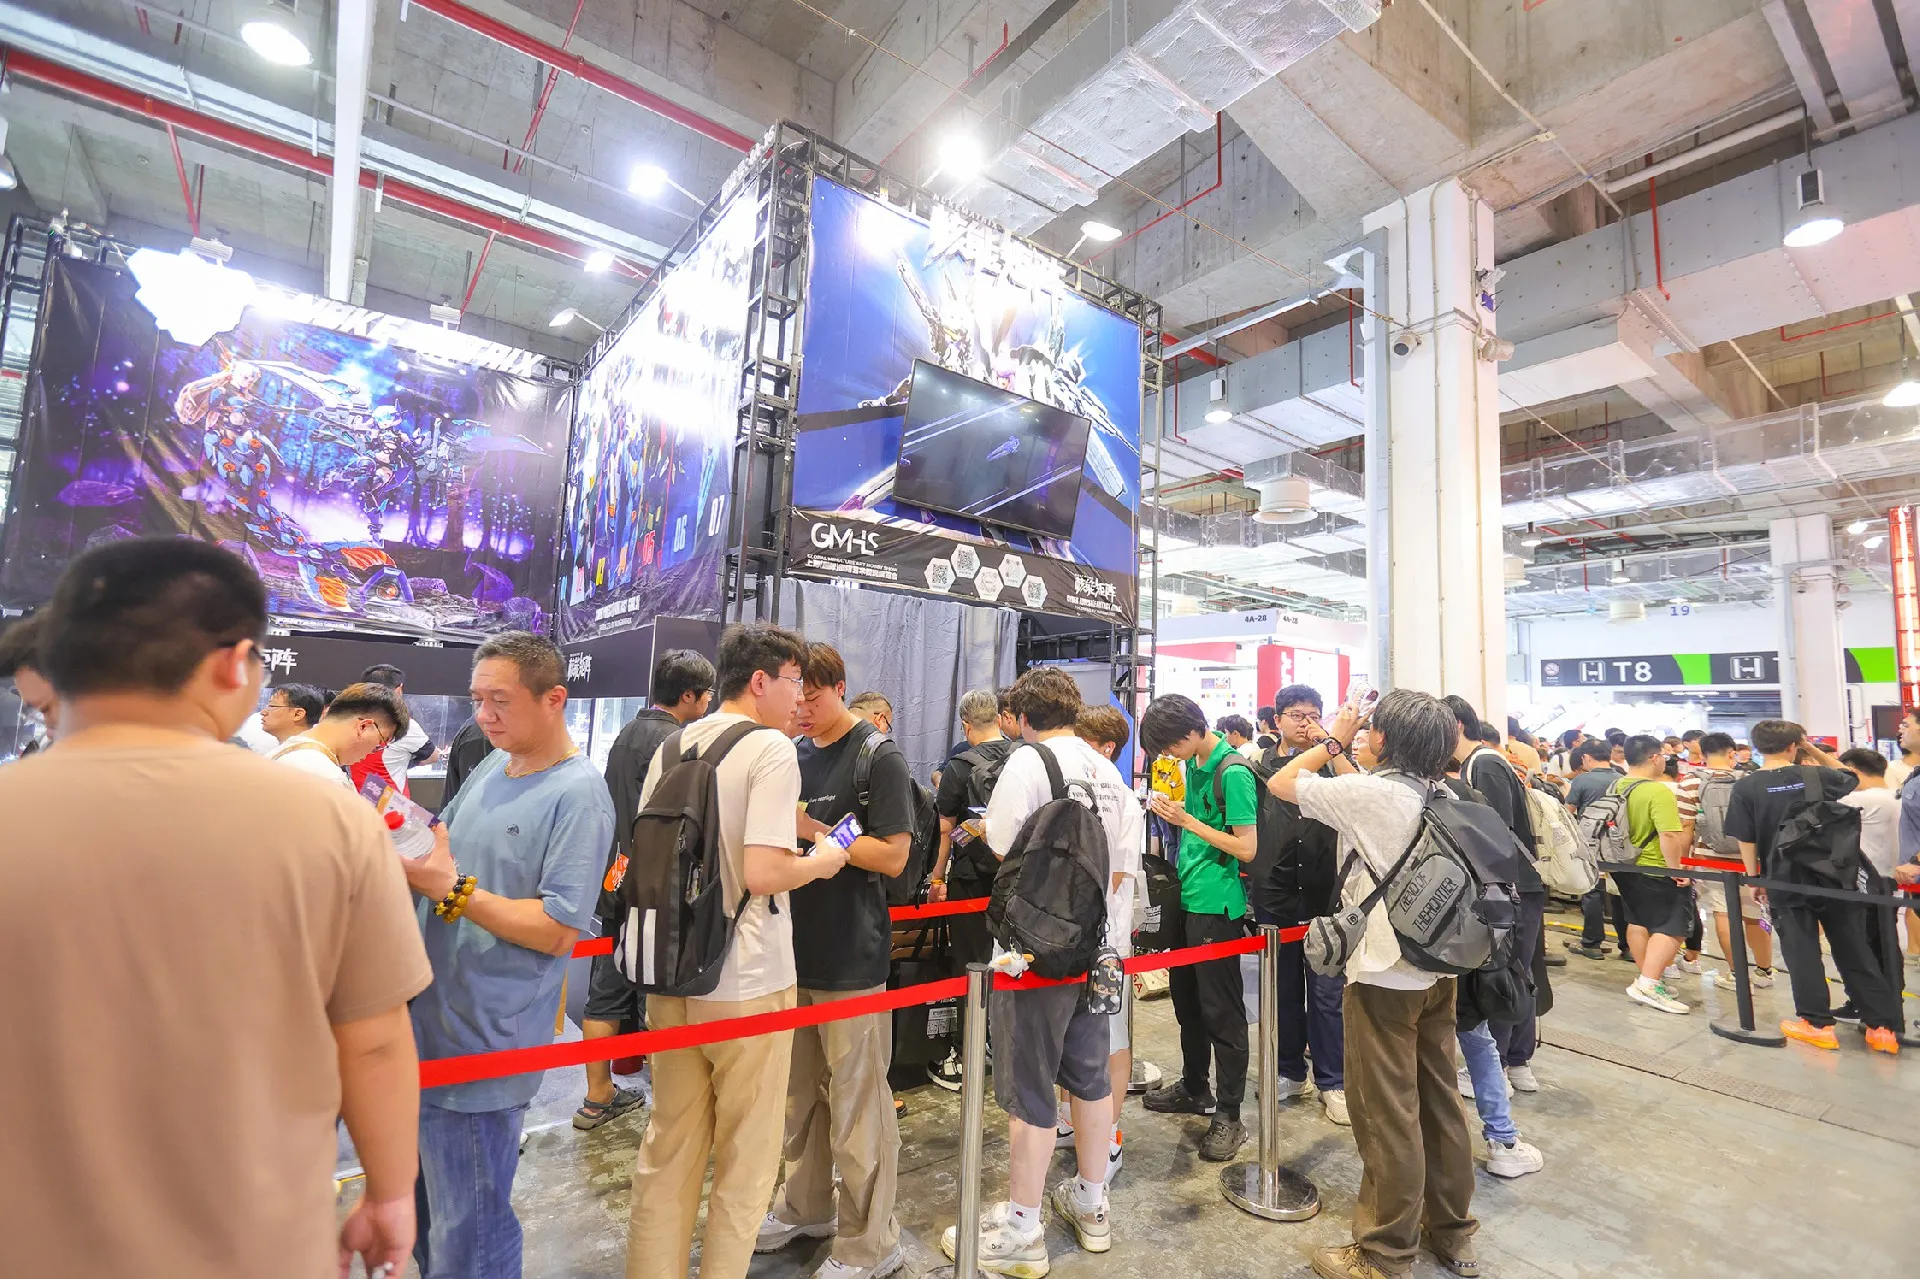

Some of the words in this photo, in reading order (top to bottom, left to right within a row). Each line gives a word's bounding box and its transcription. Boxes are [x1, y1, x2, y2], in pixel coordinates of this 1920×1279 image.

[708, 494, 725, 537] 07
[673, 514, 688, 553] 06
[642, 530, 656, 567] 05
[1245, 614, 1267, 623] 4A-28
[1670, 605, 1690, 616] 19
[1612, 661, 1653, 682] T8
